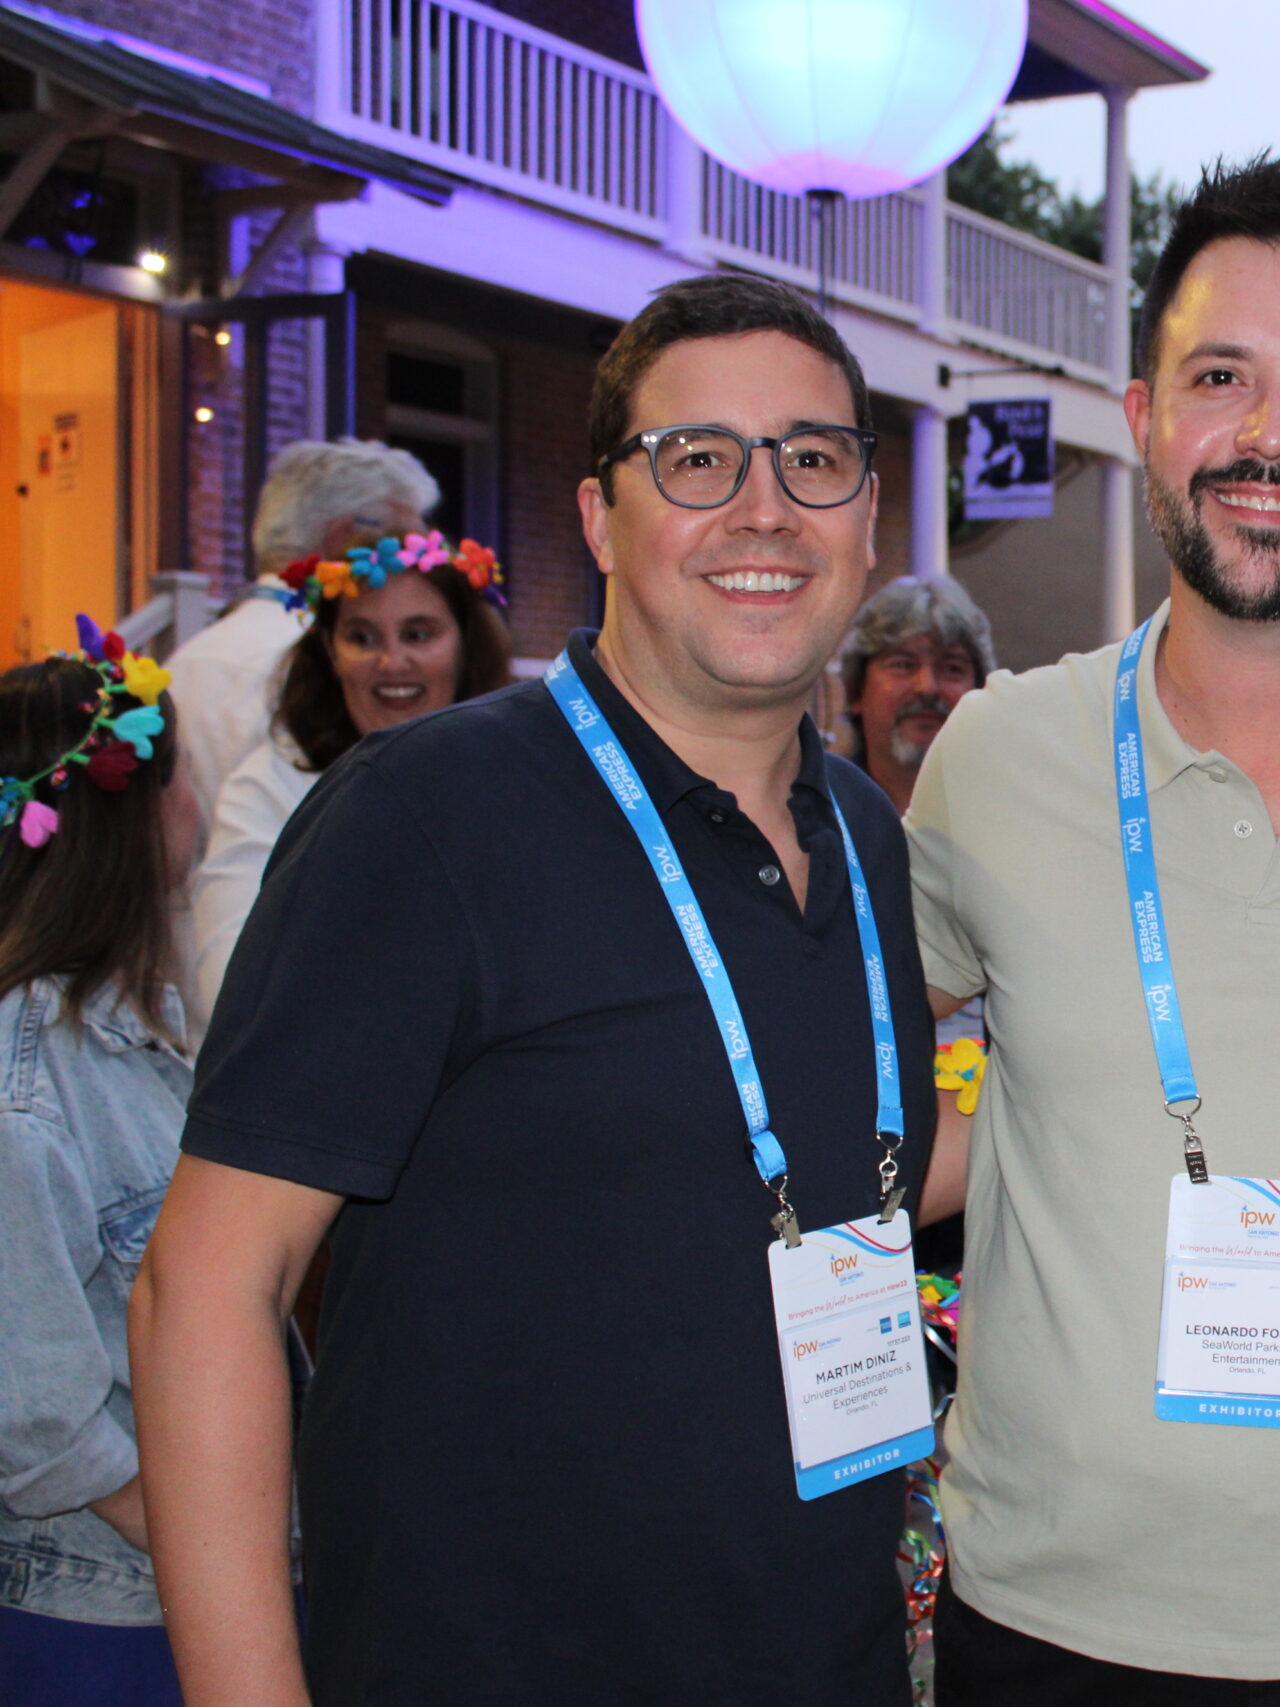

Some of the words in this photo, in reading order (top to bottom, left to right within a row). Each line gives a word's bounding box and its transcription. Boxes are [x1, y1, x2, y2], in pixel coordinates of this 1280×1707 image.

[1118, 669, 1135, 701] ipw
[569, 699, 600, 731] ipw
[591, 745, 638, 811] AMERICAN
[602, 741, 643, 801] EXPRESS
[1118, 742, 1132, 800] EXPRESS
[1127, 732, 1141, 798] AMERICAN
[1122, 817, 1146, 853] ipw
[653, 846, 682, 883] ipw
[676, 905, 715, 979] AMERICAN
[685, 903, 719, 968] EXPRESS
[1134, 901, 1154, 964] EXPRESS
[1143, 890, 1164, 962] AMERICAN
[870, 954, 889, 1023] AMERICAN
[1147, 984, 1172, 1022] ipw
[724, 1020, 750, 1060] ipw
[876, 1041, 894, 1080] ipw
[741, 1083, 758, 1135] RICAN
[750, 1081, 764, 1130] PRESS
[1240, 1205, 1275, 1228] ipw
[831, 1254, 858, 1279] ipw
[1179, 1243, 1211, 1253] Bringing
[1178, 1272, 1208, 1292] ipw
[1186, 1324, 1258, 1338] LEONARDO
[1202, 1339, 1252, 1351] SeaWorld
[793, 1340, 818, 1361] ipw
[816, 1360, 863, 1384] MARTIM
[866, 1350, 897, 1370] DINIZ
[803, 1383, 846, 1404] Universal
[849, 1365, 903, 1391] Destinations
[905, 1361, 912, 1371] &
[833, 1385, 888, 1410] Experiences
[833, 1448, 901, 1480] EXHIBITOR
